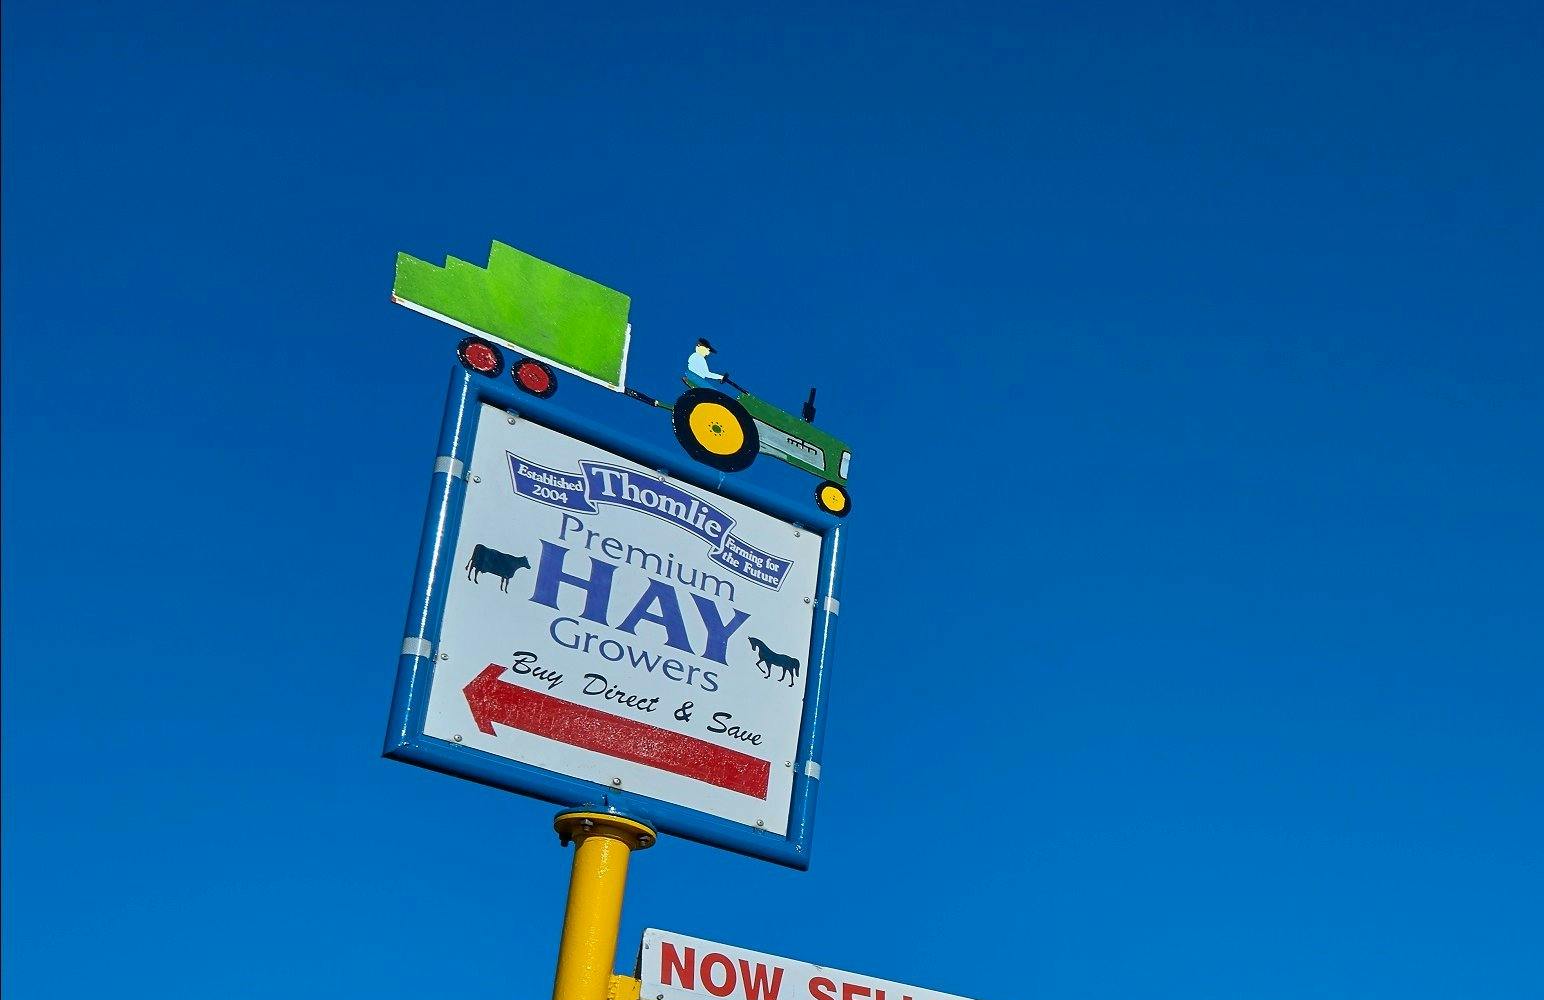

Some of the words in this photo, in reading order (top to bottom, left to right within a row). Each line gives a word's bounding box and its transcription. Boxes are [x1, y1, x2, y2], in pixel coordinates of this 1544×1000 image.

[517, 463, 584, 492] Established
[532, 484, 568, 504] 2004
[591, 467, 722, 538] Thomlie
[559, 512, 735, 602] Premium
[721, 552, 740, 568] the
[743, 561, 779, 585] Future
[725, 536, 763, 568] Farming
[765, 558, 780, 573] for
[528, 538, 751, 666] HAY
[549, 616, 719, 692] Growers
[511, 651, 564, 690] Buy
[582, 673, 660, 713] Direct
[673, 701, 694, 722] &
[706, 712, 763, 746] Save
